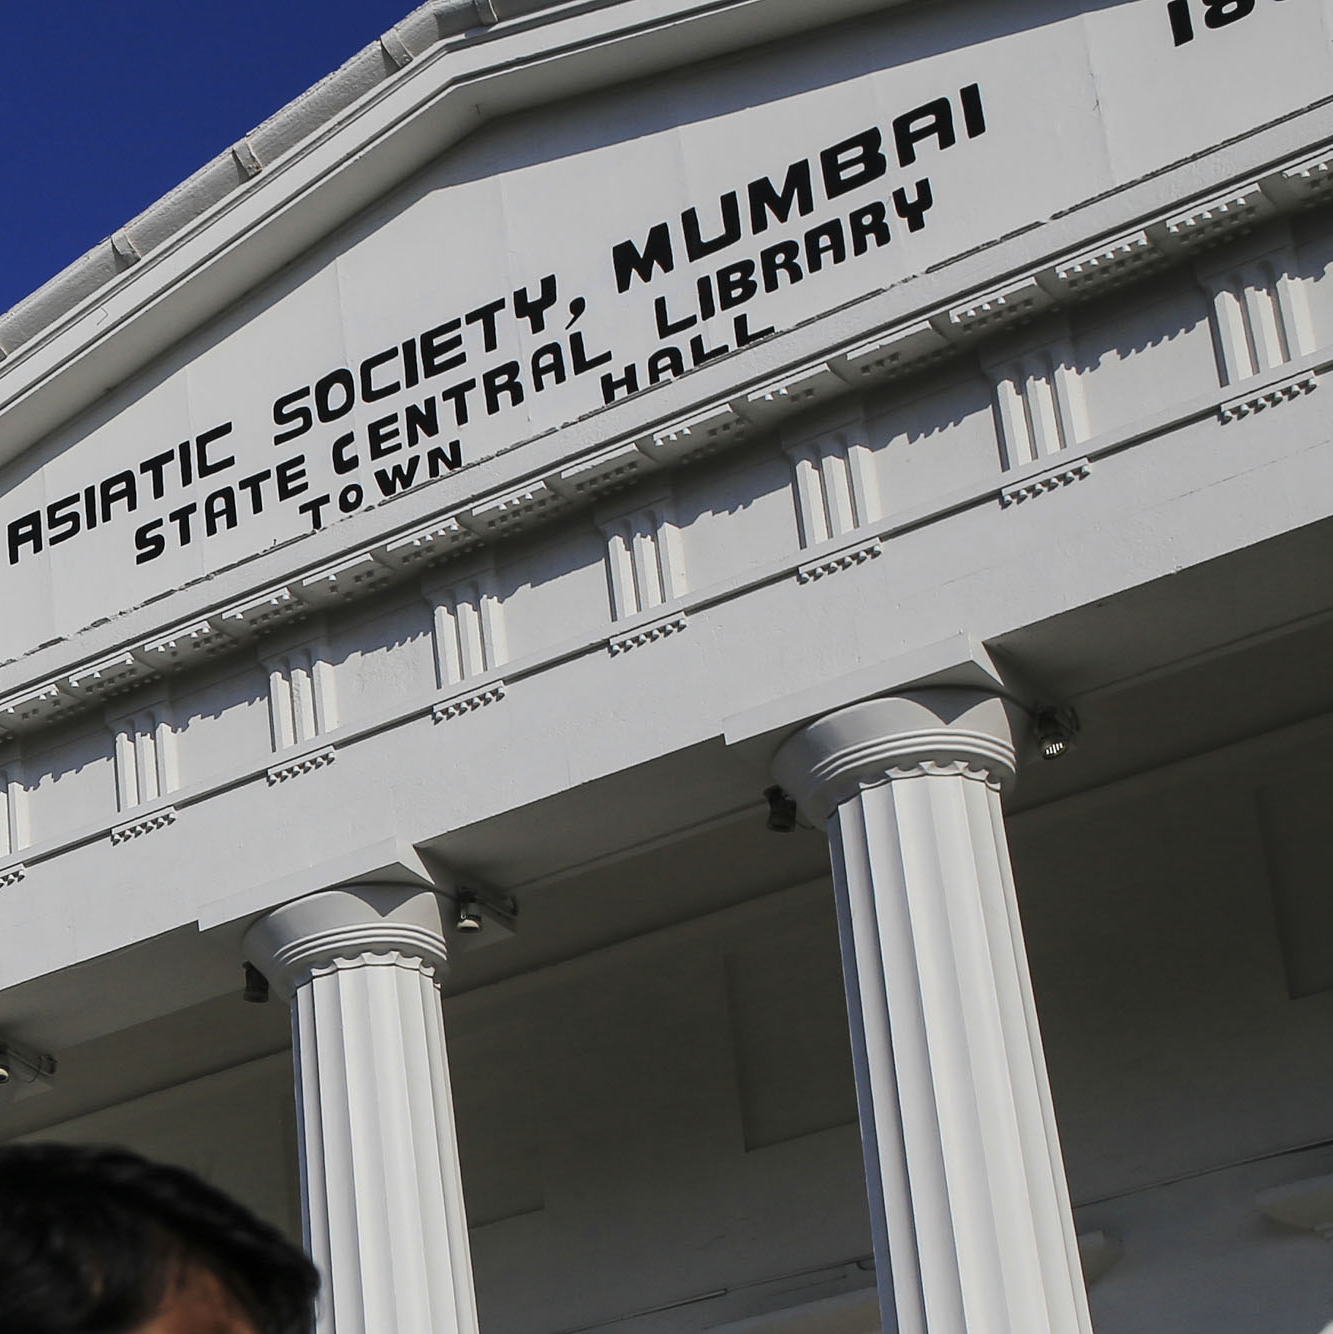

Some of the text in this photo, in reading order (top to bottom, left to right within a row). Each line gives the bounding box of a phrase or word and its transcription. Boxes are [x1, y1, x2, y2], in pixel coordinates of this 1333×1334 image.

[7, 421, 235, 565] ASIATIC
[273, 274, 586, 446] SOCIETY,
[612, 83, 986, 294] MUMBAI
[1167, 0, 1289, 47] 18
[134, 177, 933, 565] STATE CENTRAL LIBRARY
[298, 313, 775, 530] TOWN HALL
